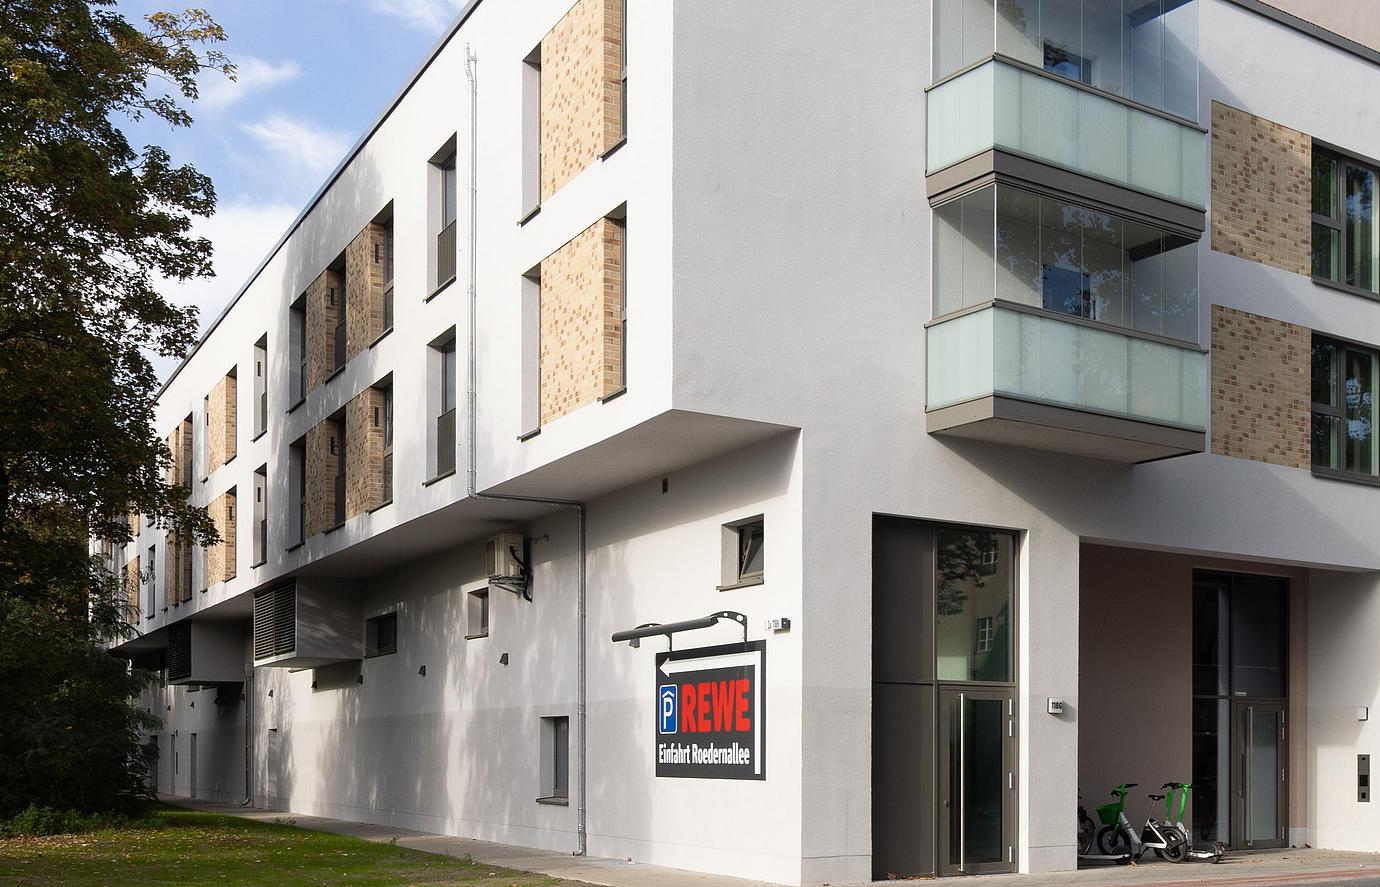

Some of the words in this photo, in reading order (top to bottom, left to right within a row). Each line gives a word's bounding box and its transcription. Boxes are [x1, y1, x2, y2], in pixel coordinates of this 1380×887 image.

[663, 697, 673, 730] P
[681, 679, 750, 733] REWE
[658, 743, 691, 764] Einfahrt
[692, 742, 750, 765] Roedernallee
